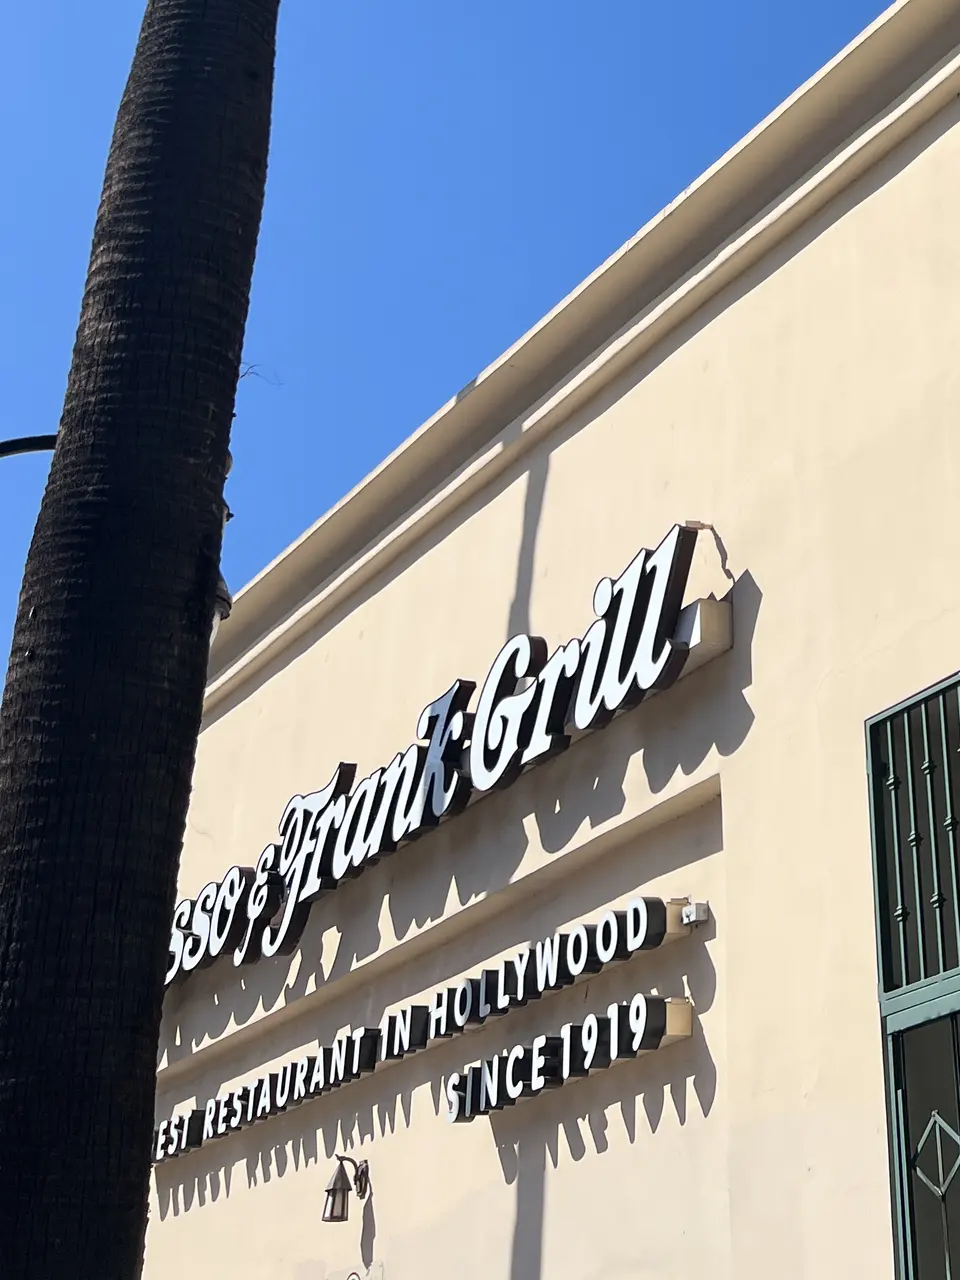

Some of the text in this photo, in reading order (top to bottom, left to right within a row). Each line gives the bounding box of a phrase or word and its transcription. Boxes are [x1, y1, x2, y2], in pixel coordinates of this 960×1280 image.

[233, 843, 276, 967] &
[261, 680, 467, 958] Frank
[468, 523, 684, 792] Grill
[203, 1027, 366, 1140] RESTAURANT
[380, 1010, 415, 1061] IN
[430, 896, 650, 1038] HOLLYWOOD
[445, 992, 650, 1123] SINCE 1919
